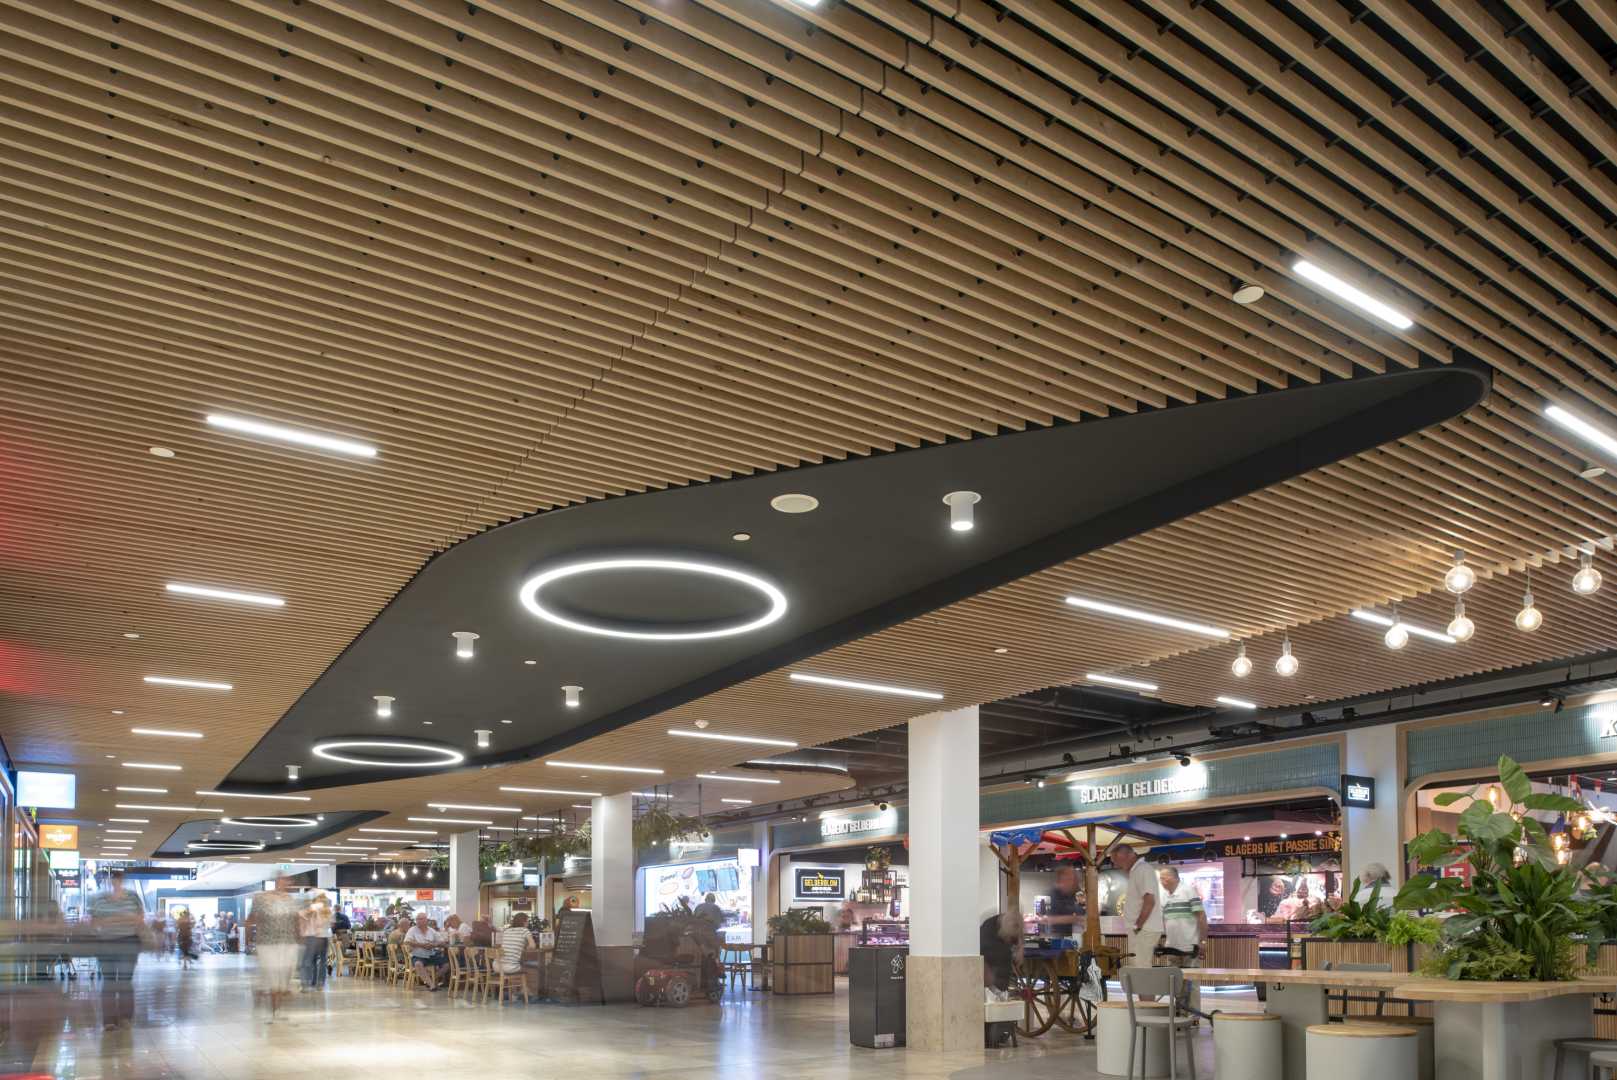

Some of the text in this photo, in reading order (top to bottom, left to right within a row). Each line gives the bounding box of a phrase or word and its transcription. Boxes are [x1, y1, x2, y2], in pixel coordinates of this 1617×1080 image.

[1080, 775, 1208, 804] SLAGERIJ GELDER
[1224, 843, 1263, 856] SLAGERS
[1265, 841, 1283, 854] MET
[1286, 839, 1317, 852] PASSIE
